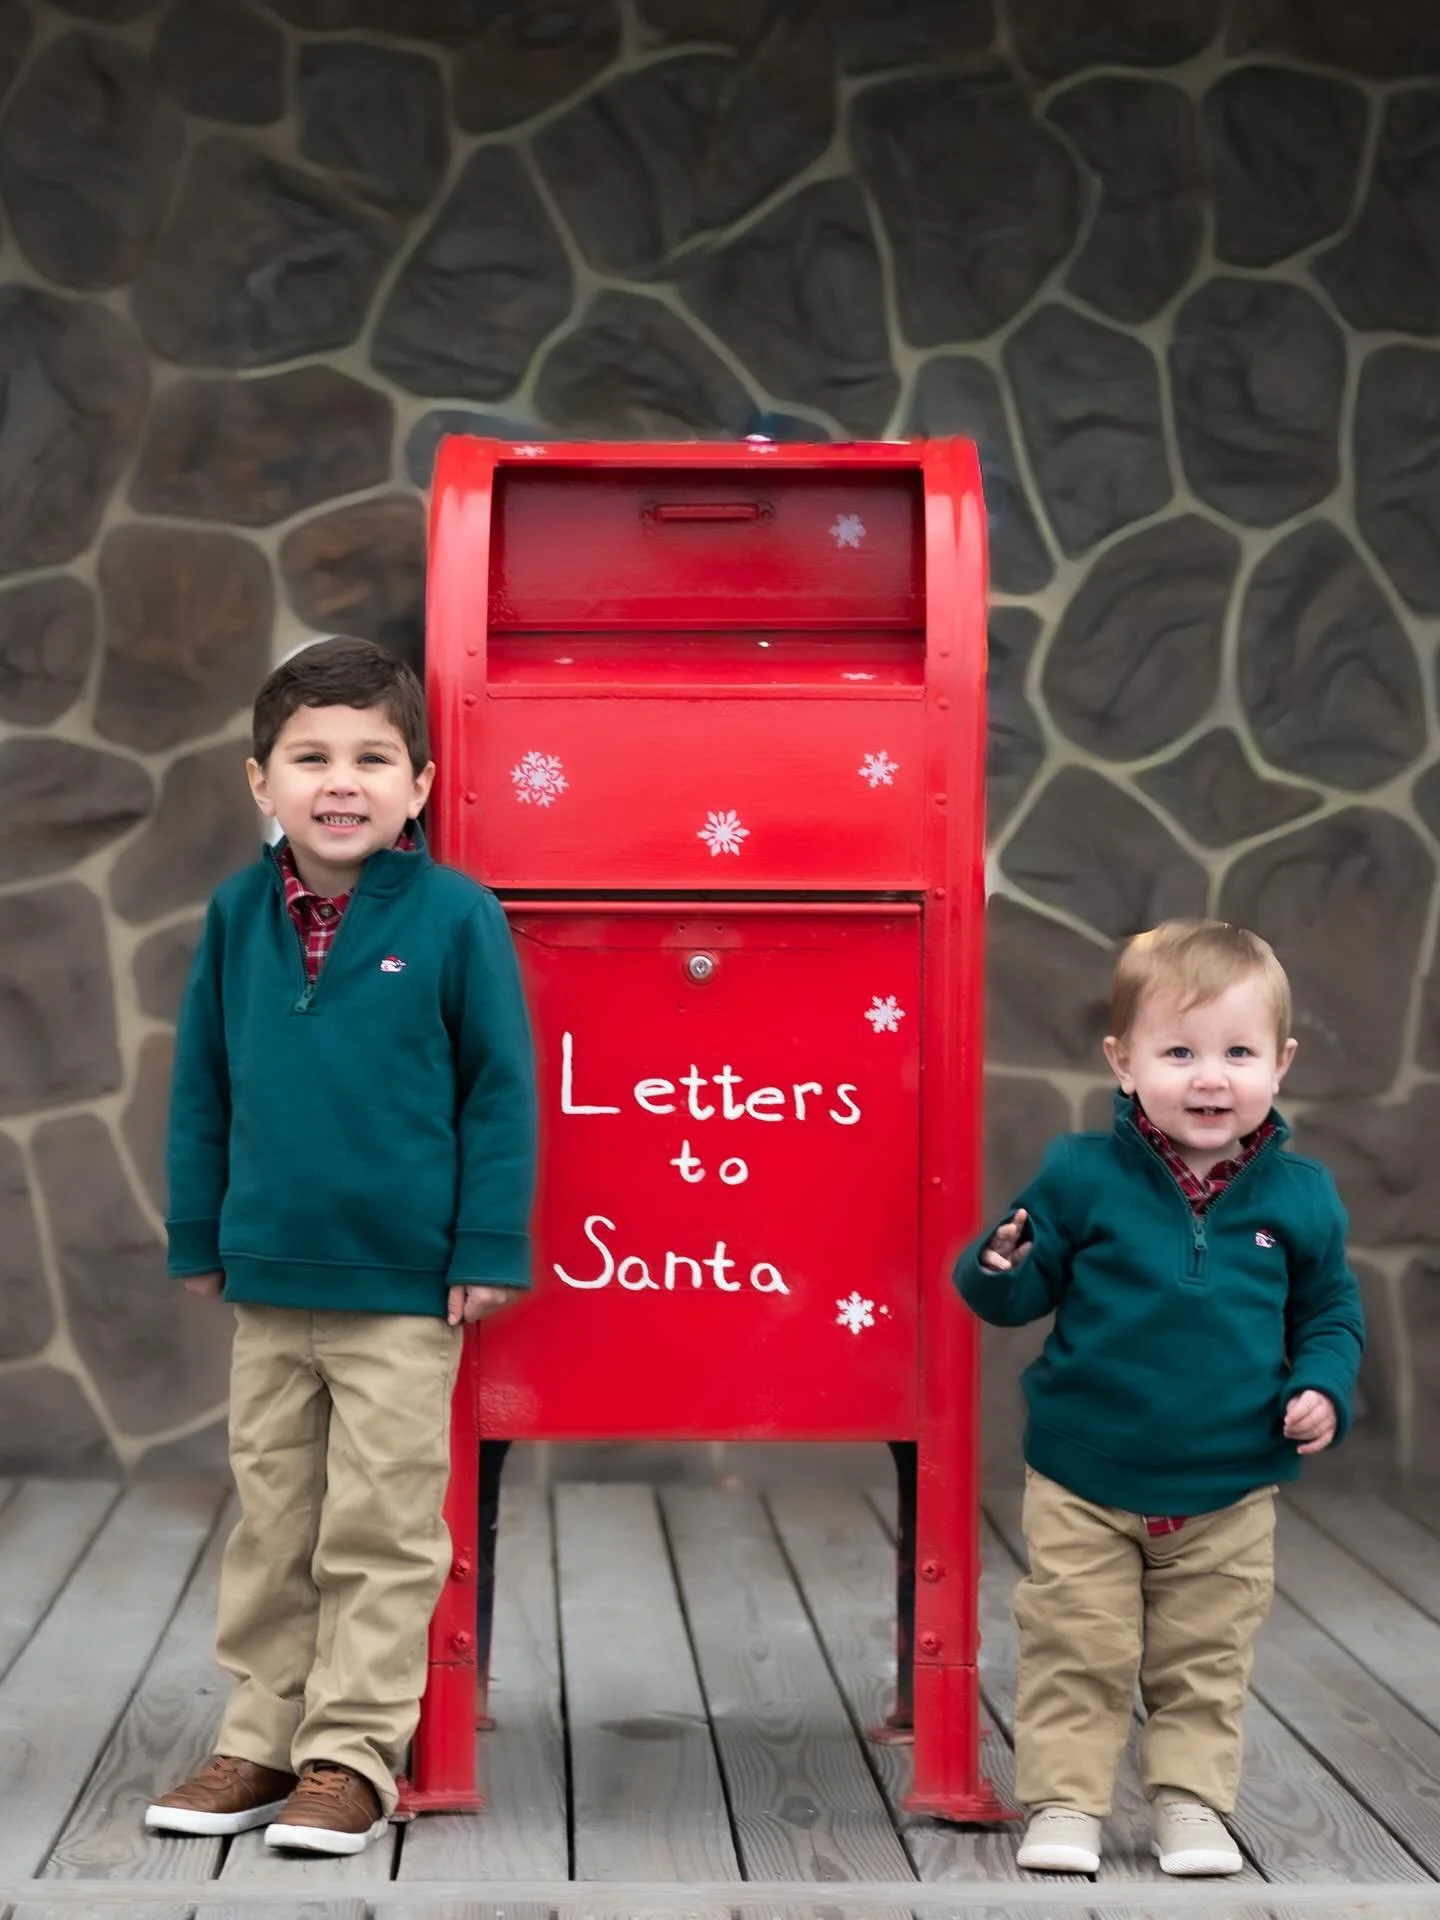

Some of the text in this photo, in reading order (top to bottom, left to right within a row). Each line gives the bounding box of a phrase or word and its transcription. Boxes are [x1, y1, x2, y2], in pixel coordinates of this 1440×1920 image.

[561, 1031, 861, 1125] Letters
[670, 1139, 749, 1185] to
[553, 1215, 791, 1295] Santa
